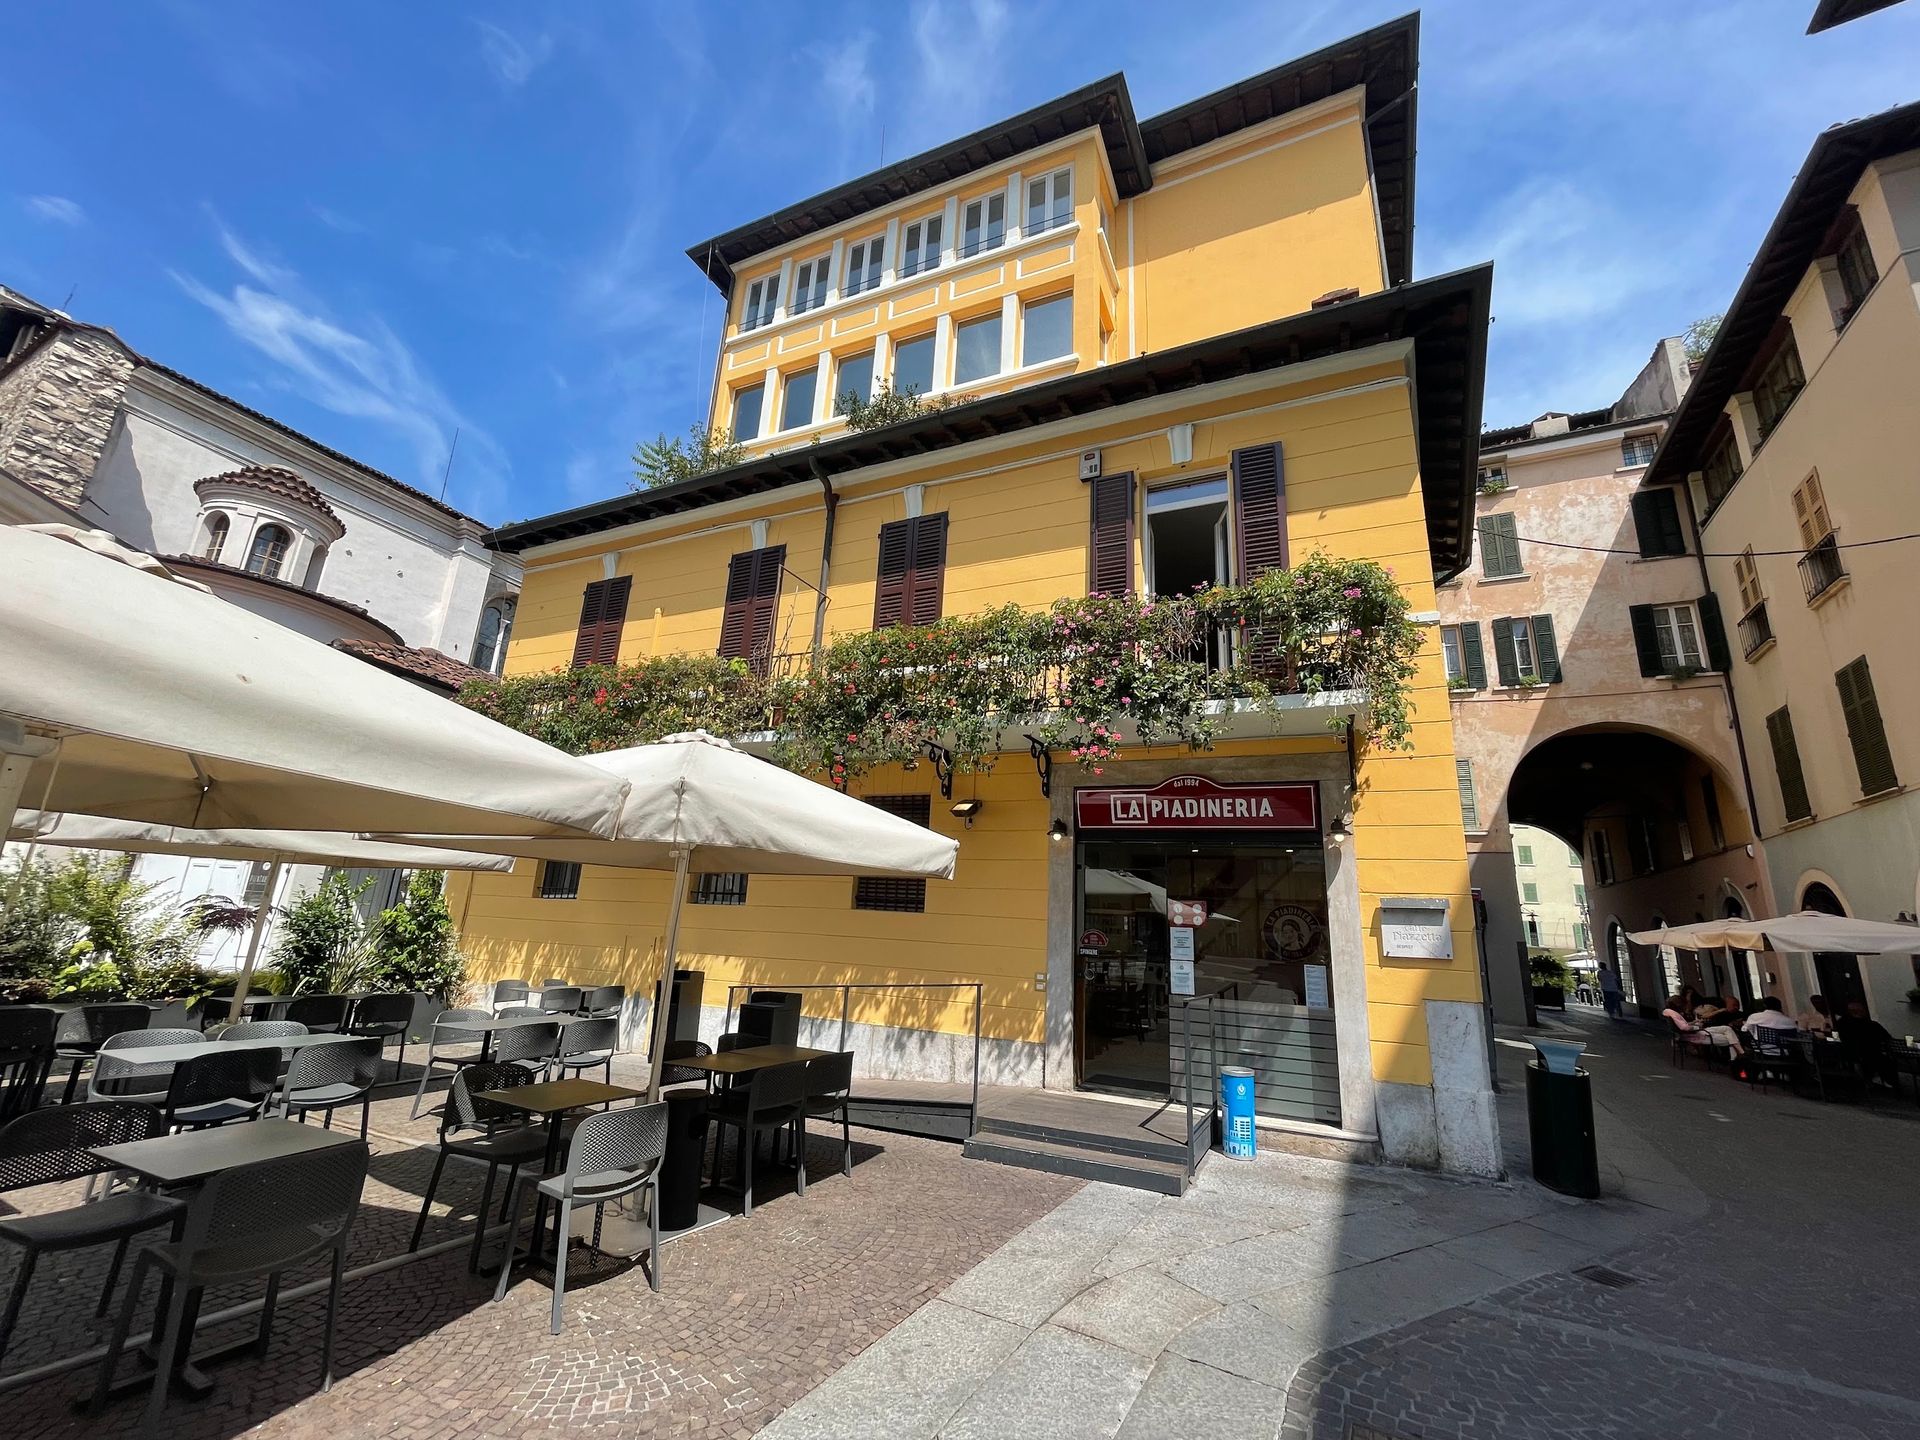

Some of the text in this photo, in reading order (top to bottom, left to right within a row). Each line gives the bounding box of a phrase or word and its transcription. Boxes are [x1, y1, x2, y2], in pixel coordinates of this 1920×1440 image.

[1173, 778, 1200, 788] dal 1994
[1116, 798, 1274, 818] LA PIADINERIA
